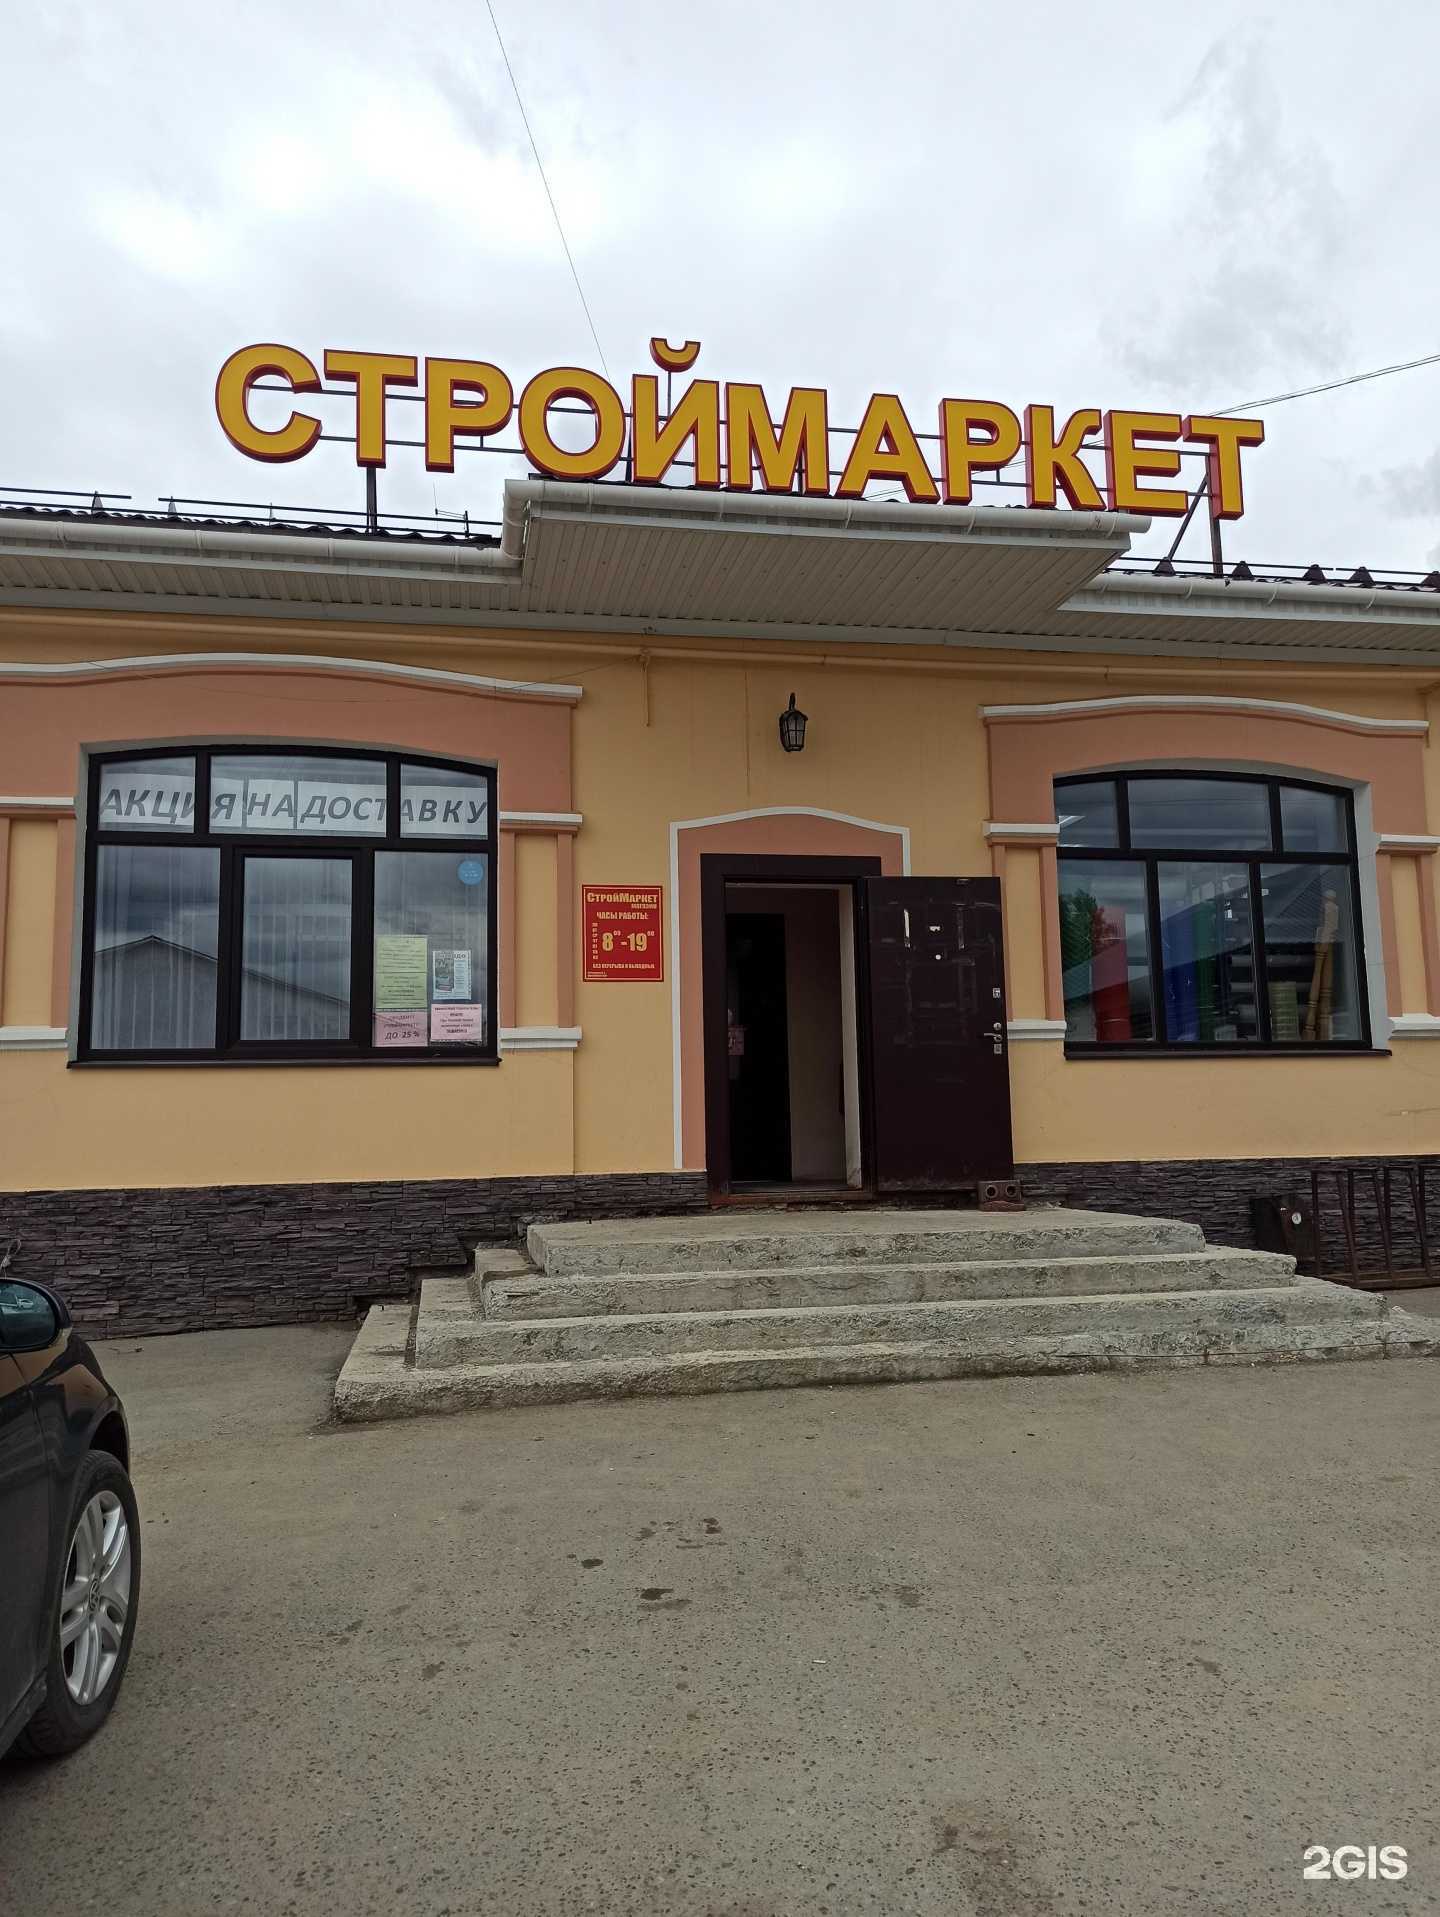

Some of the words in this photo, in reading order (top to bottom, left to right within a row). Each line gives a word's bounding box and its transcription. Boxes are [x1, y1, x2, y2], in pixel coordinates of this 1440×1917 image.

[215, 337, 1265, 520] СТРОЙМАРКЕТ
[248, 792, 295, 818] НА
[300, 793, 488, 825] ДОСТАВКУ
